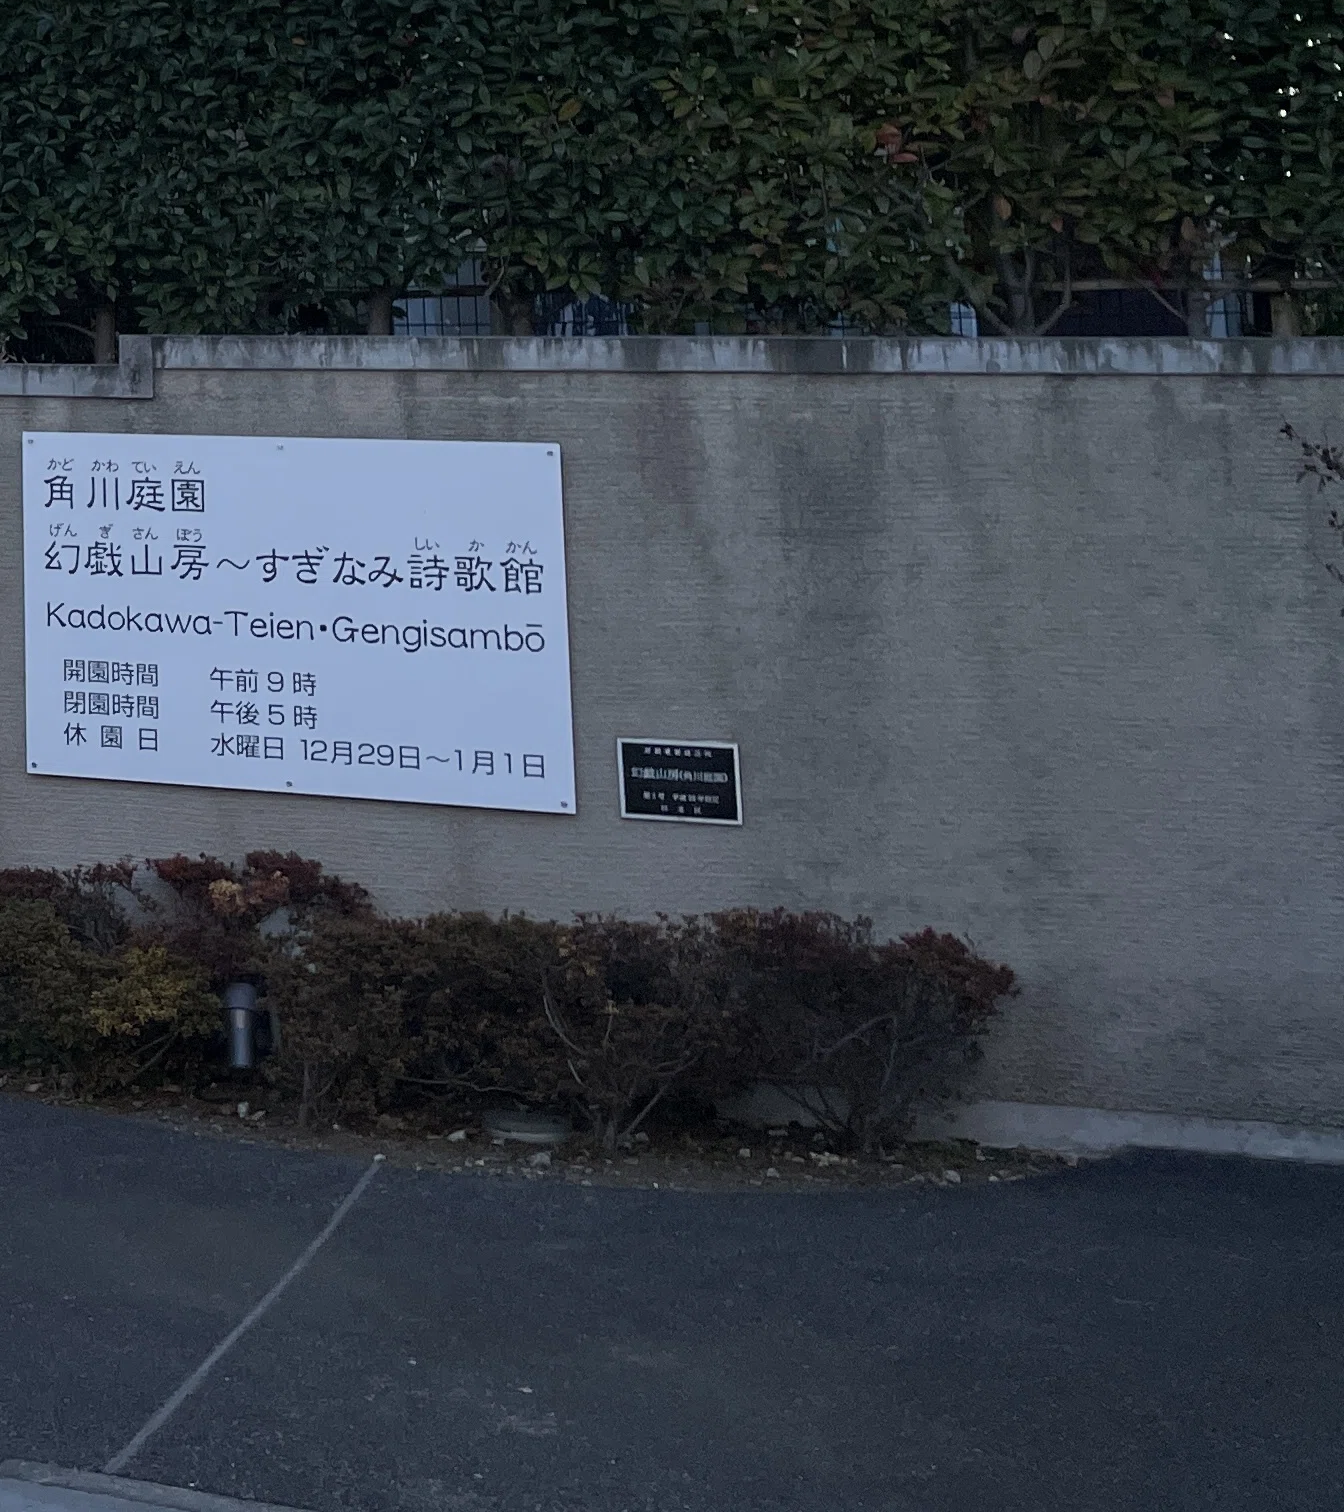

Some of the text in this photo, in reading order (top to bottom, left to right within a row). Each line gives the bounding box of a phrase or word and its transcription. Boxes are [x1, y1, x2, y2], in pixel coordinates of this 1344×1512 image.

[47, 458, 200, 474] かど かわ てい えん
[44, 475, 204, 512] 角川庭園
[50, 523, 77, 537] げん
[133, 528, 158, 540] さん
[469, 539, 484, 552] か
[506, 541, 537, 555] かん
[64, 659, 158, 687] 開園時間
[64, 691, 159, 719] 閉園時間
[211, 733, 283, 760] 水曜日
